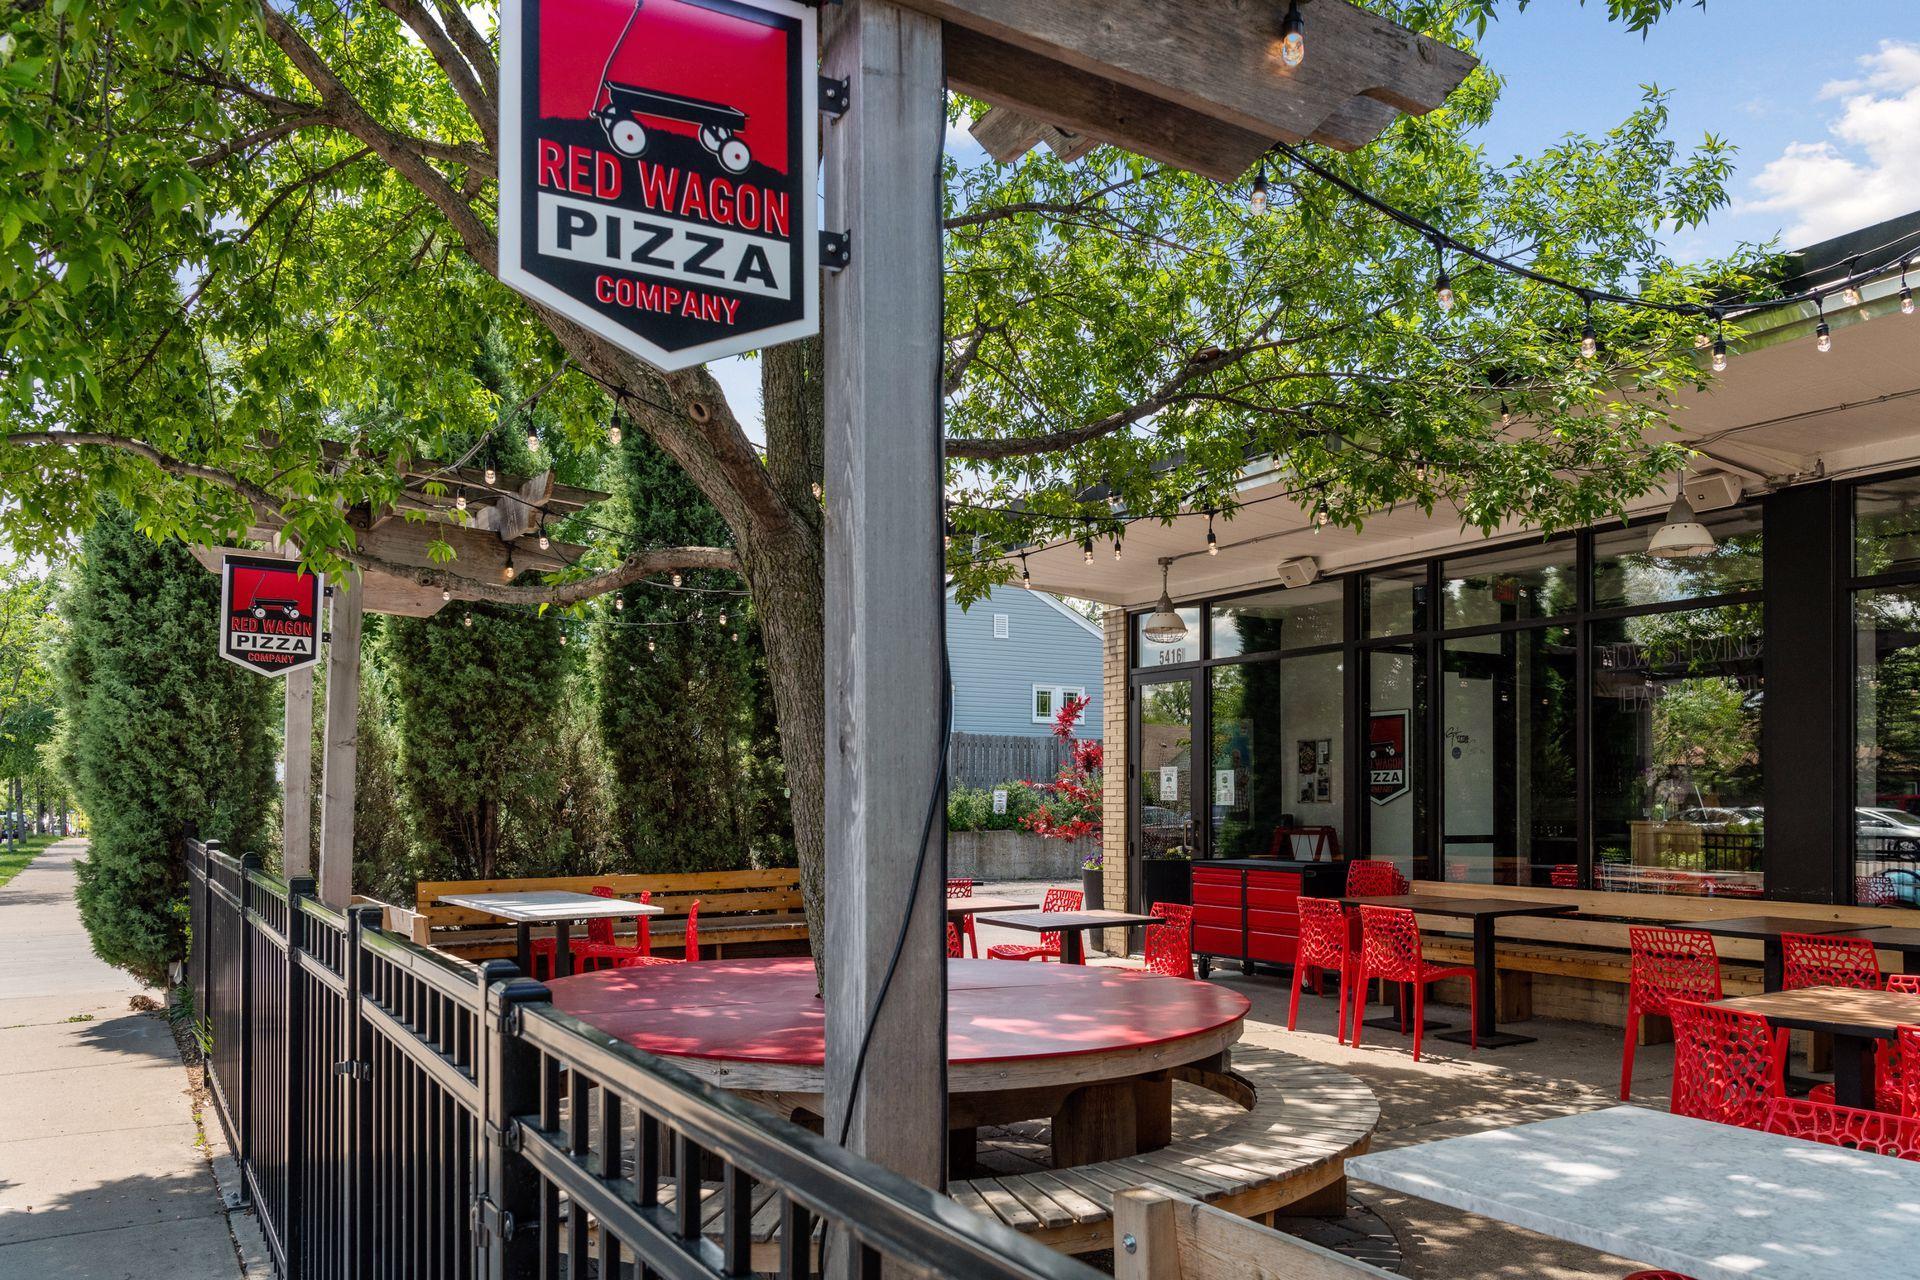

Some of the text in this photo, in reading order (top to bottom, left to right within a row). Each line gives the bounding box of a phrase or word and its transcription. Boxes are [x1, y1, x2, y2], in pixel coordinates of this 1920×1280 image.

[538, 138, 791, 238] RED WAGON
[556, 204, 779, 290] PIZZA
[596, 274, 741, 326] COMPANY
[231, 616, 313, 637] RED WAGON
[236, 634, 308, 652] PIZZA
[247, 651, 295, 664] COMPANY
[1159, 647, 1182, 665] 5416
[1372, 772, 1400, 783] ZZA
